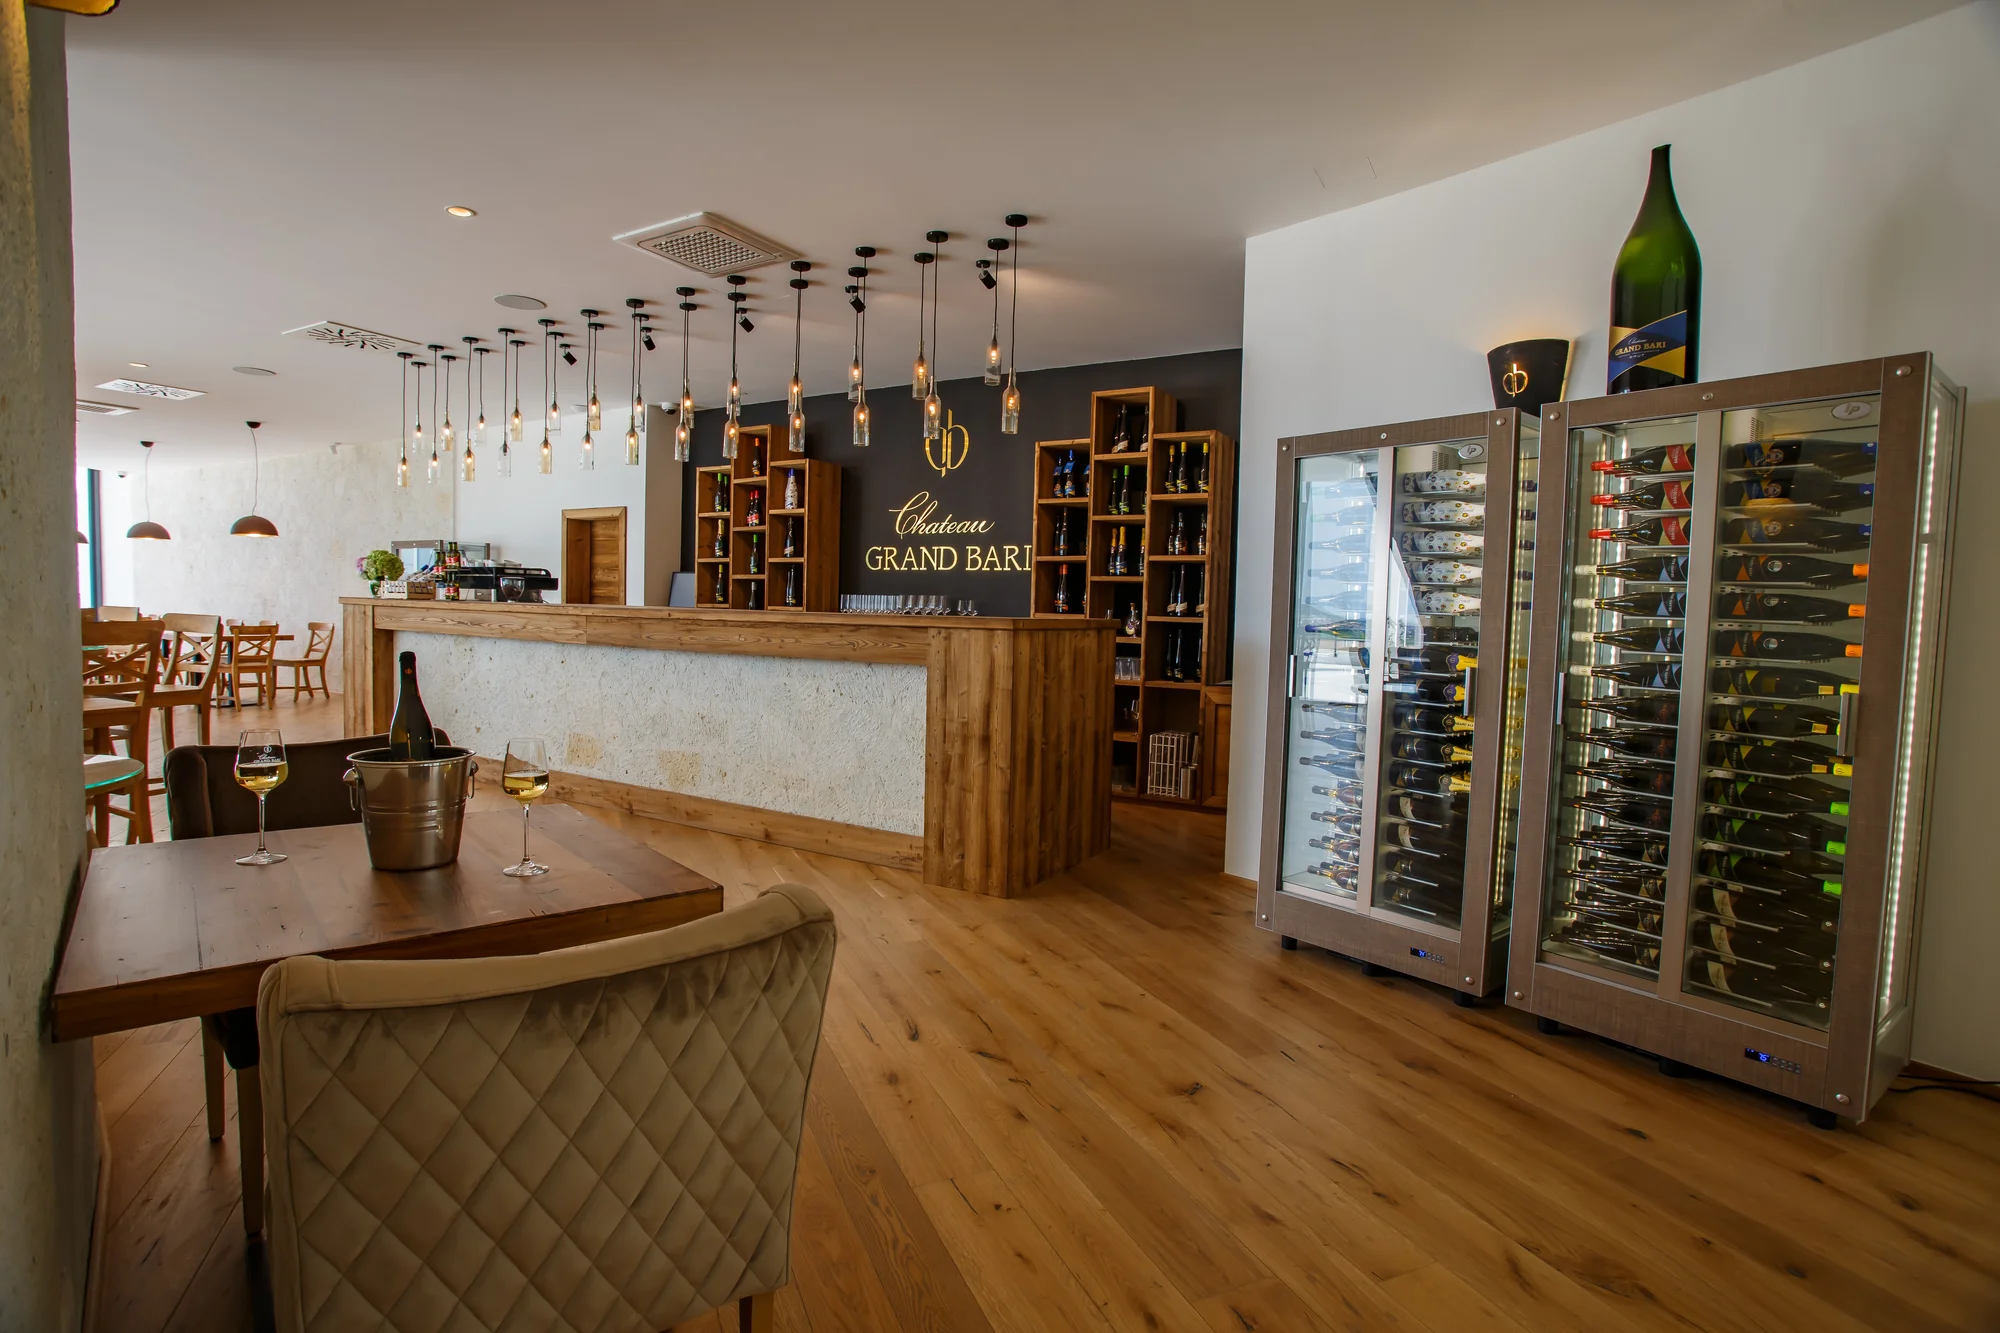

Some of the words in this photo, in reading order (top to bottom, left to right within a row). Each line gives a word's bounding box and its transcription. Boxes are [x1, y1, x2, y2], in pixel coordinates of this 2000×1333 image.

[1615, 344, 1642, 356] GRAND
[1643, 341, 1667, 350] BARI
[888, 491, 996, 540] Chateau
[865, 545, 958, 572] GRAND
[965, 544, 1032, 572] BARI
